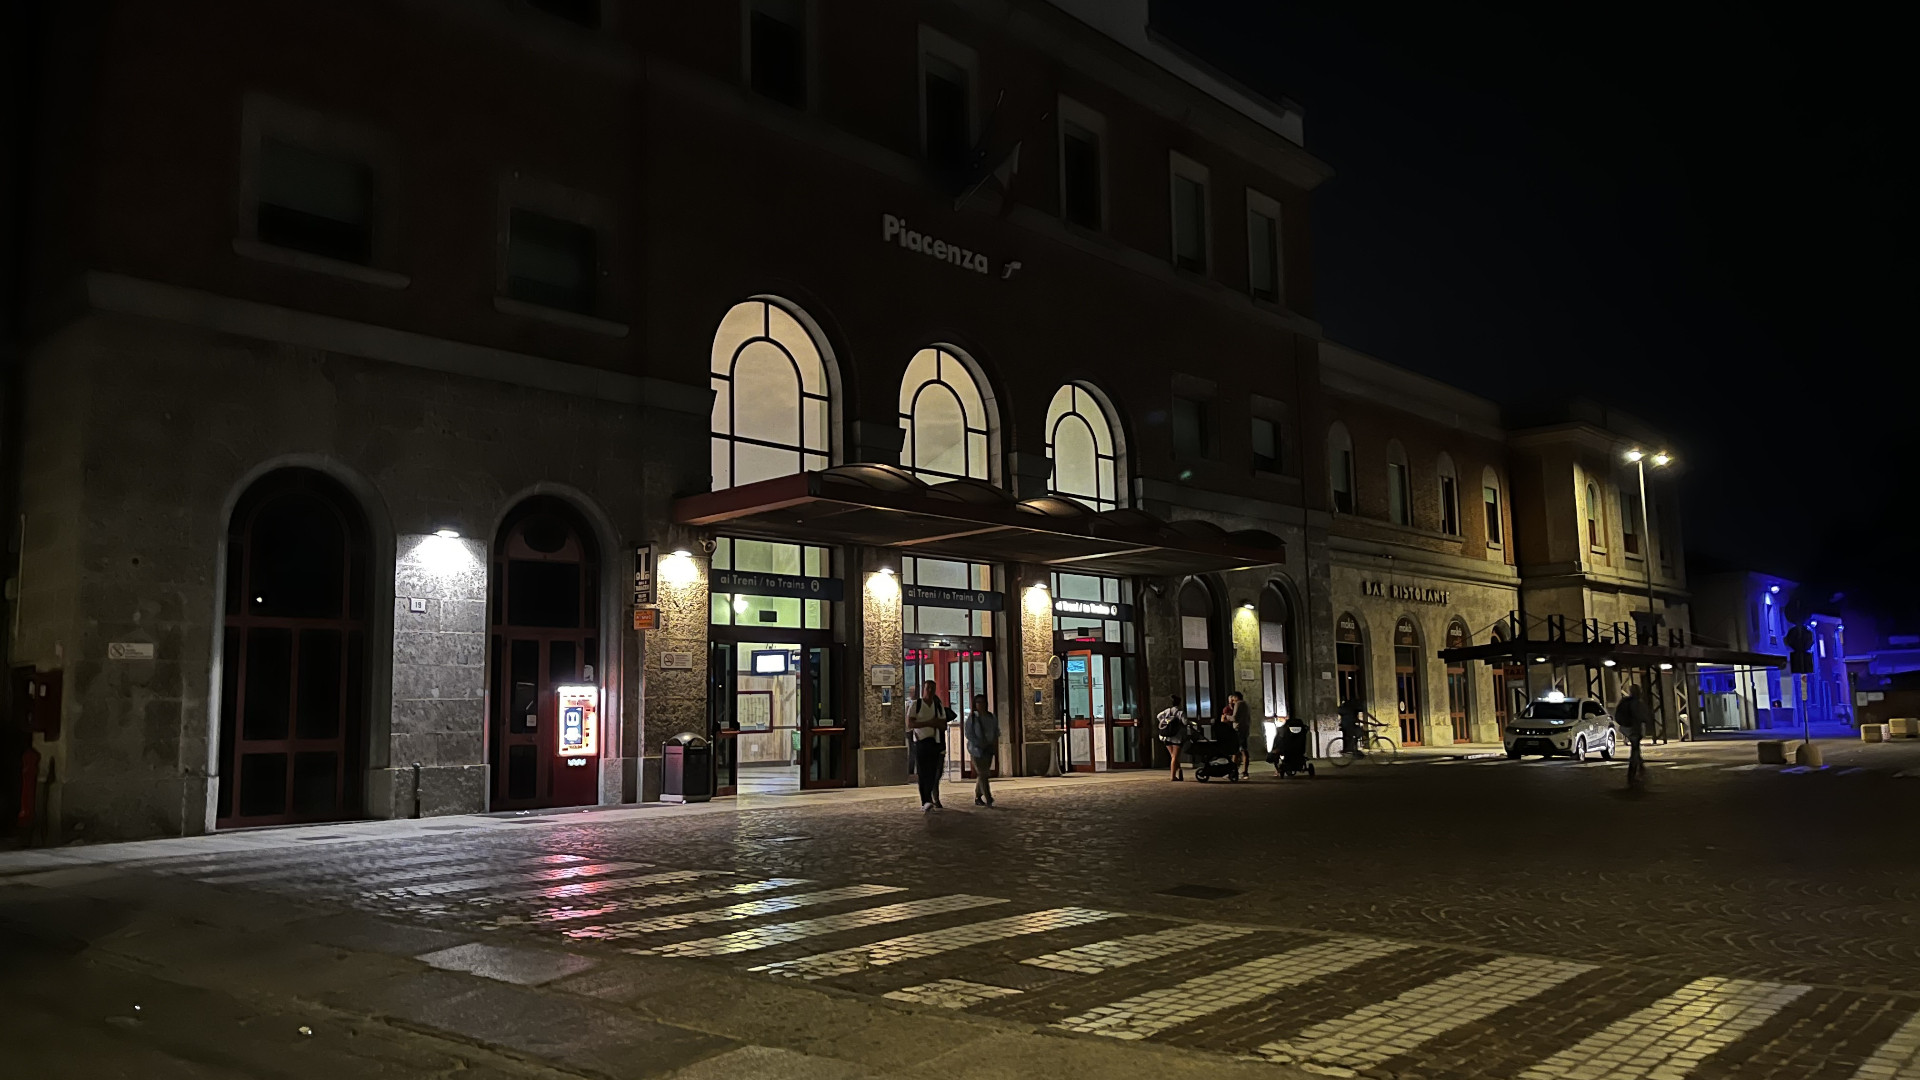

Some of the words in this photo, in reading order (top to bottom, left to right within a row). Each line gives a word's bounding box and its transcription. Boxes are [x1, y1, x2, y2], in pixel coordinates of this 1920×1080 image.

[883, 213, 988, 274] Piacenza
[720, 574, 730, 584] ai
[732, 574, 757, 586] Treni
[766, 578, 775, 587] to
[778, 578, 805, 589] Trains
[908, 588, 916, 597] ai
[917, 589, 936, 598] Treni
[943, 591, 950, 599] to
[952, 592, 973, 601] Trains
[1364, 581, 1386, 597] BAR
[1391, 585, 1450, 604] RISTORANTE
